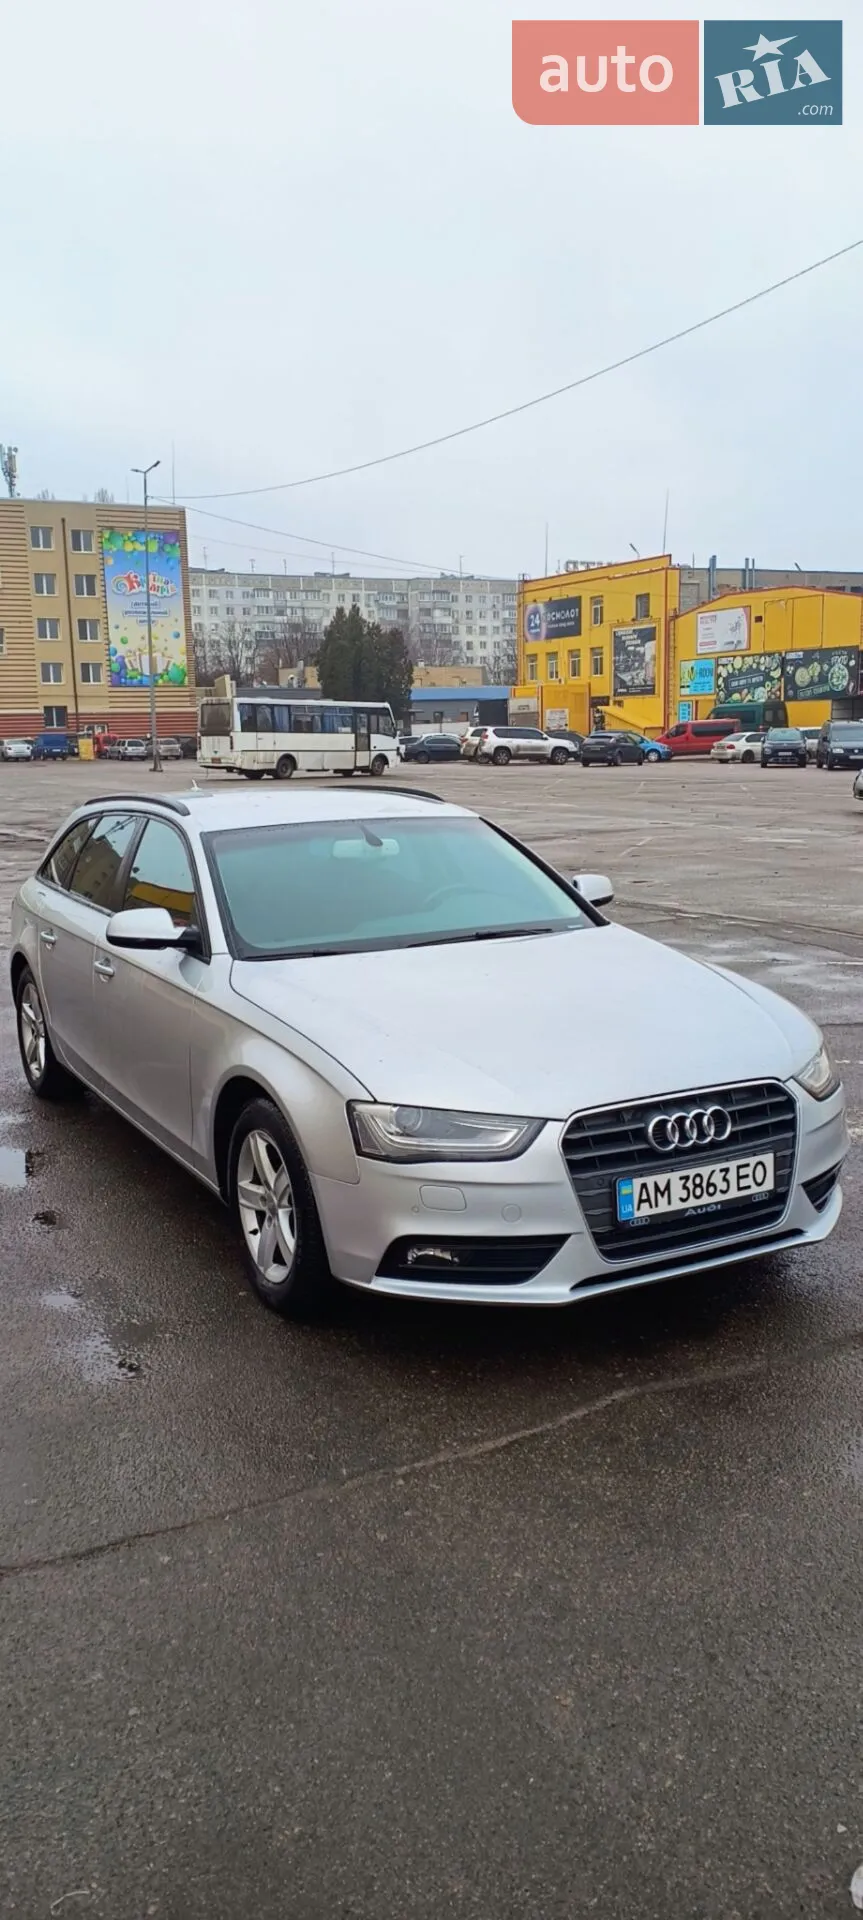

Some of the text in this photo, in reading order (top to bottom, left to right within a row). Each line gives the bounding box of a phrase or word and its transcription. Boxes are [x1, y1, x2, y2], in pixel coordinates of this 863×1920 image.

[636, 1160, 767, 1211] AM 3863 EO
[621, 1204, 633, 1214] UA
